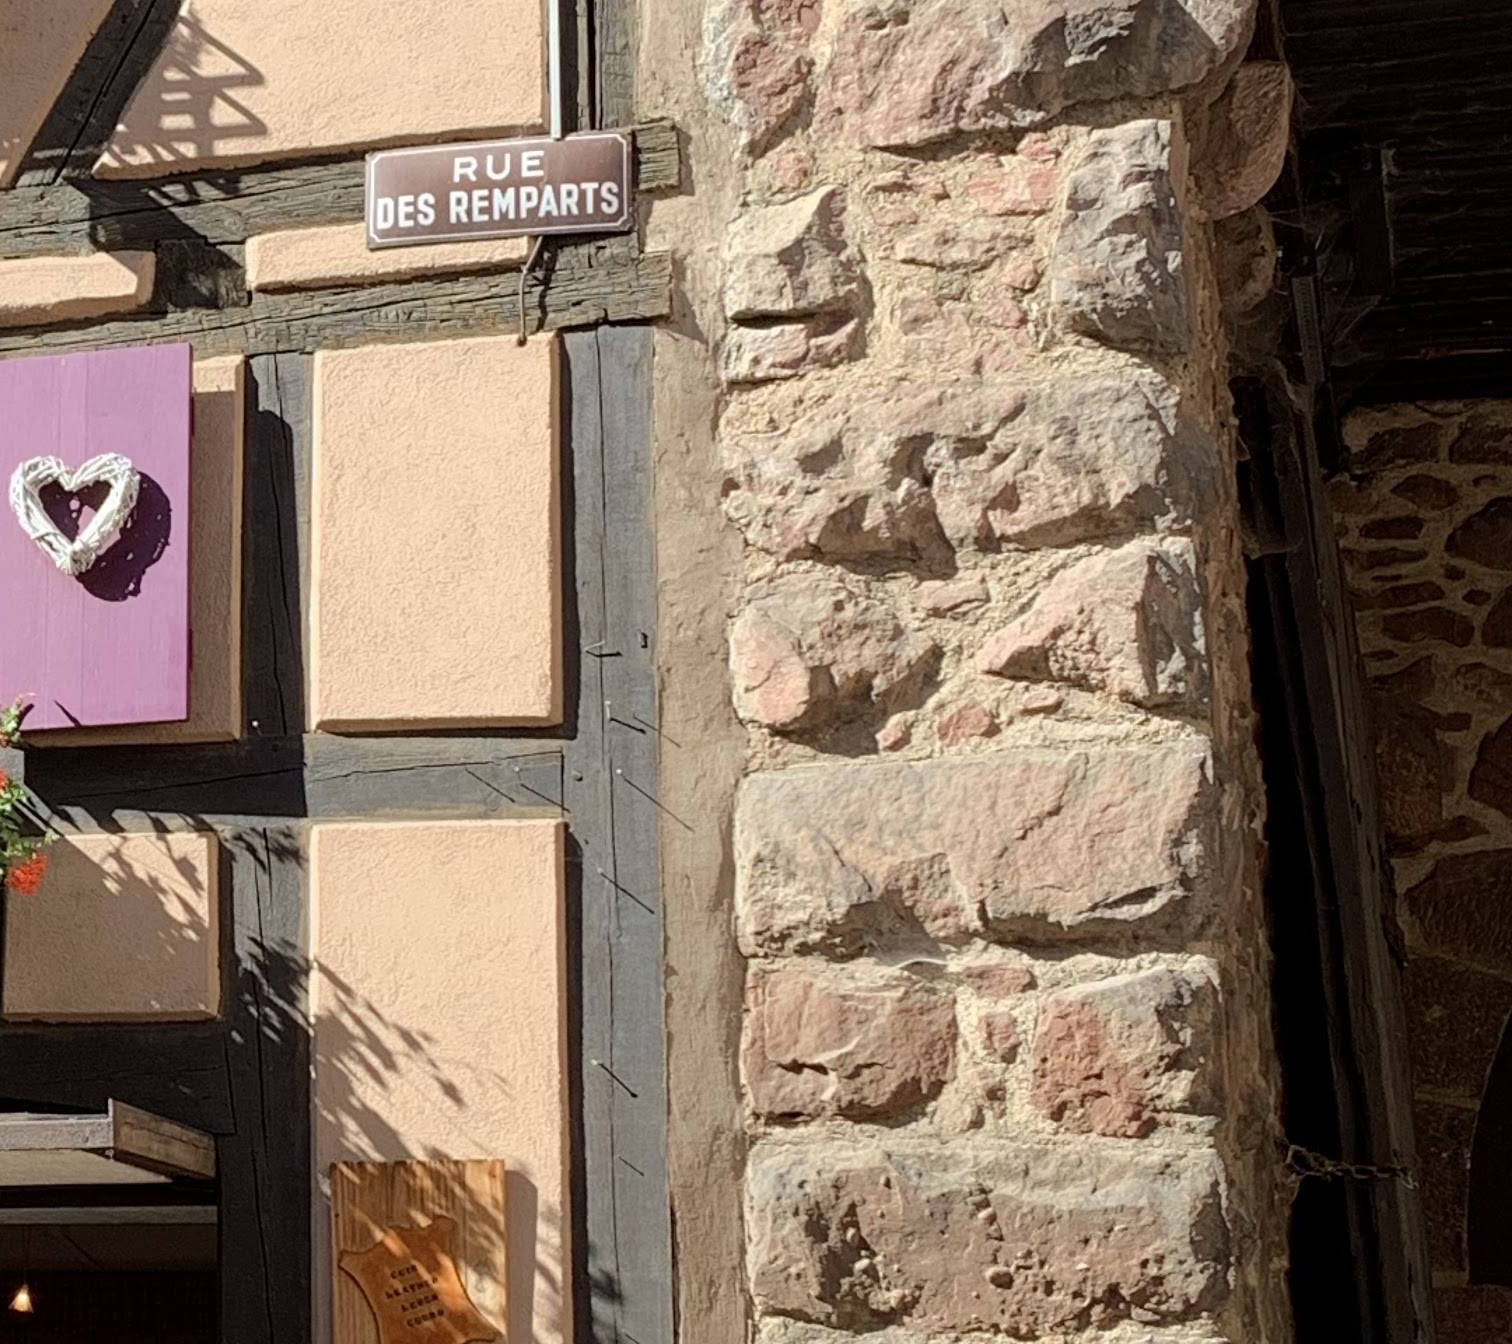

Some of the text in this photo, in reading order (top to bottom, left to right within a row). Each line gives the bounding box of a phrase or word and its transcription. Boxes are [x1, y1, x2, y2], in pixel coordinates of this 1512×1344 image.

[452, 150, 545, 183] RUE
[376, 181, 620, 231] DES REMPARTS
